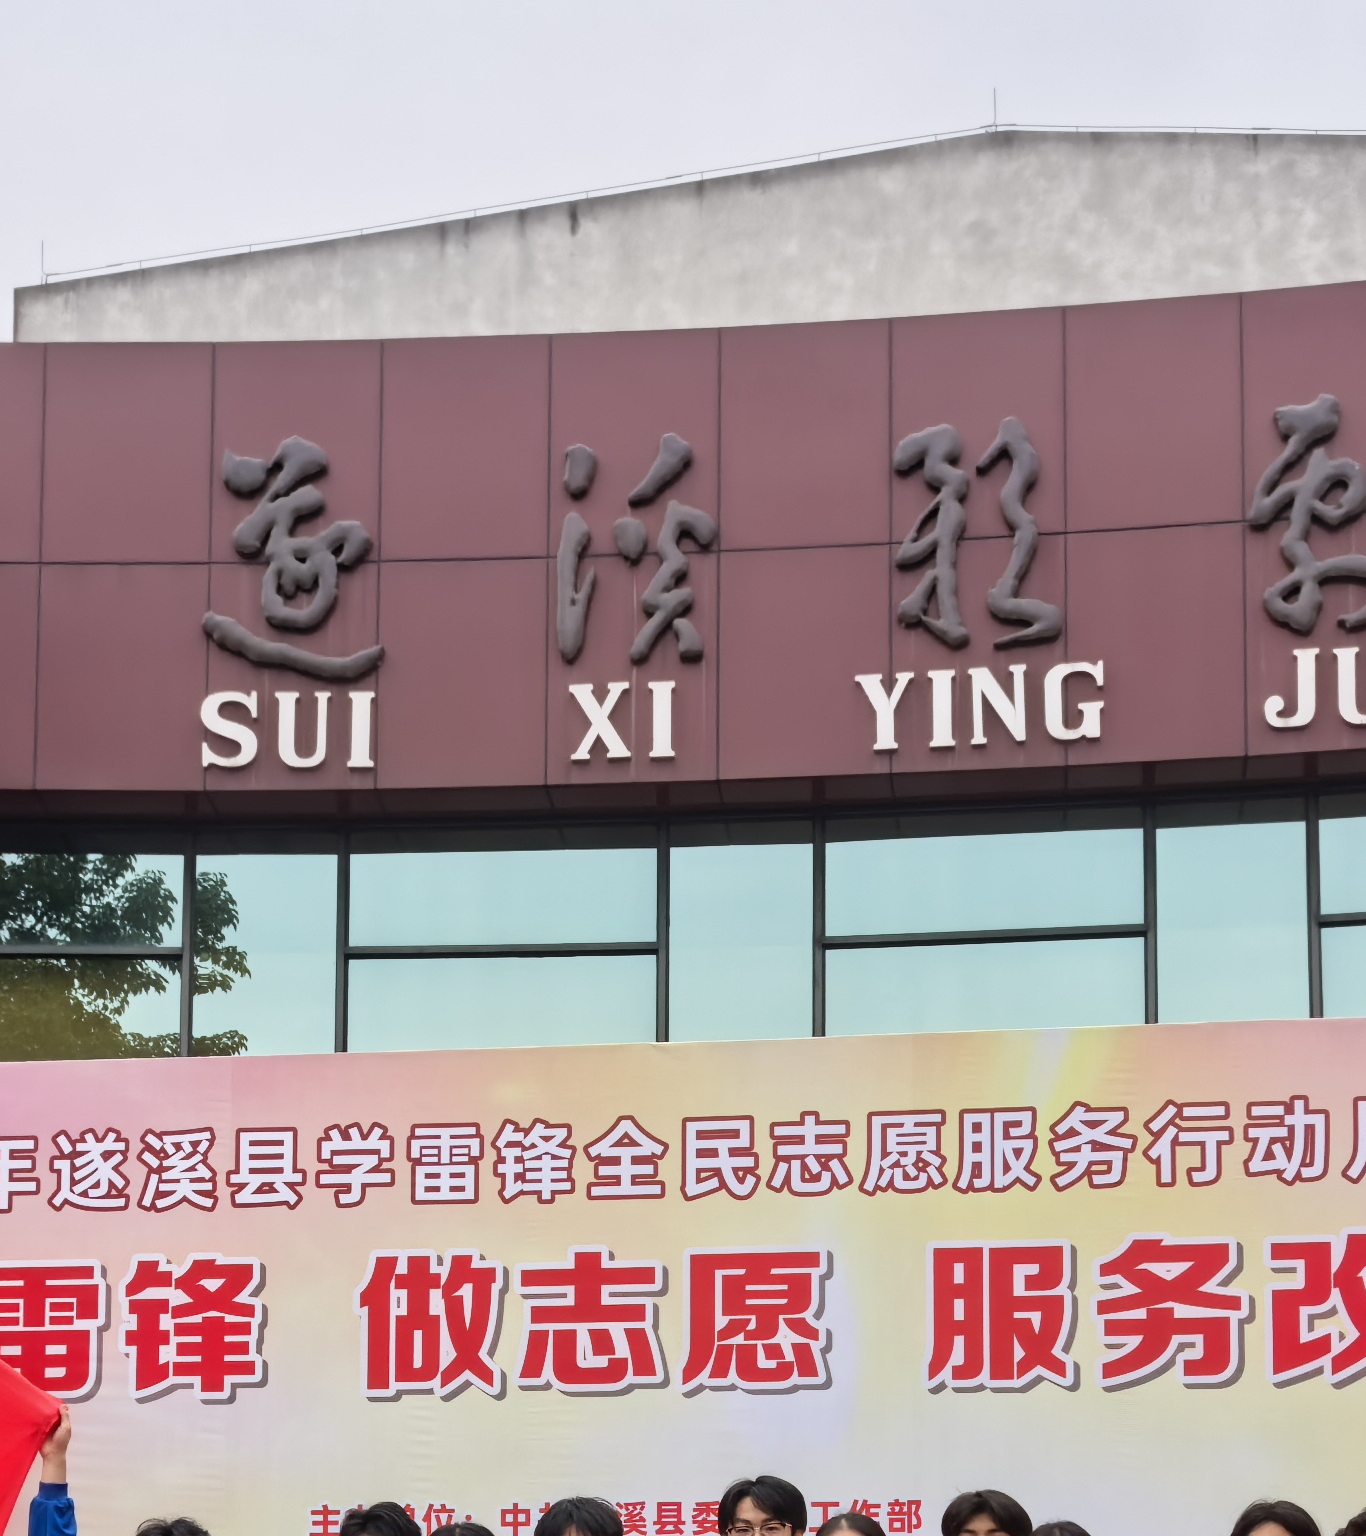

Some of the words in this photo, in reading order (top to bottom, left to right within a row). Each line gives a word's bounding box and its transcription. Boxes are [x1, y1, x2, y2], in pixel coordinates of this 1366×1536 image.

[200, 690, 377, 769] SUI
[569, 680, 677, 760] XI
[855, 660, 1106, 751] YING
[354, 1243, 832, 1401] 做志愿
